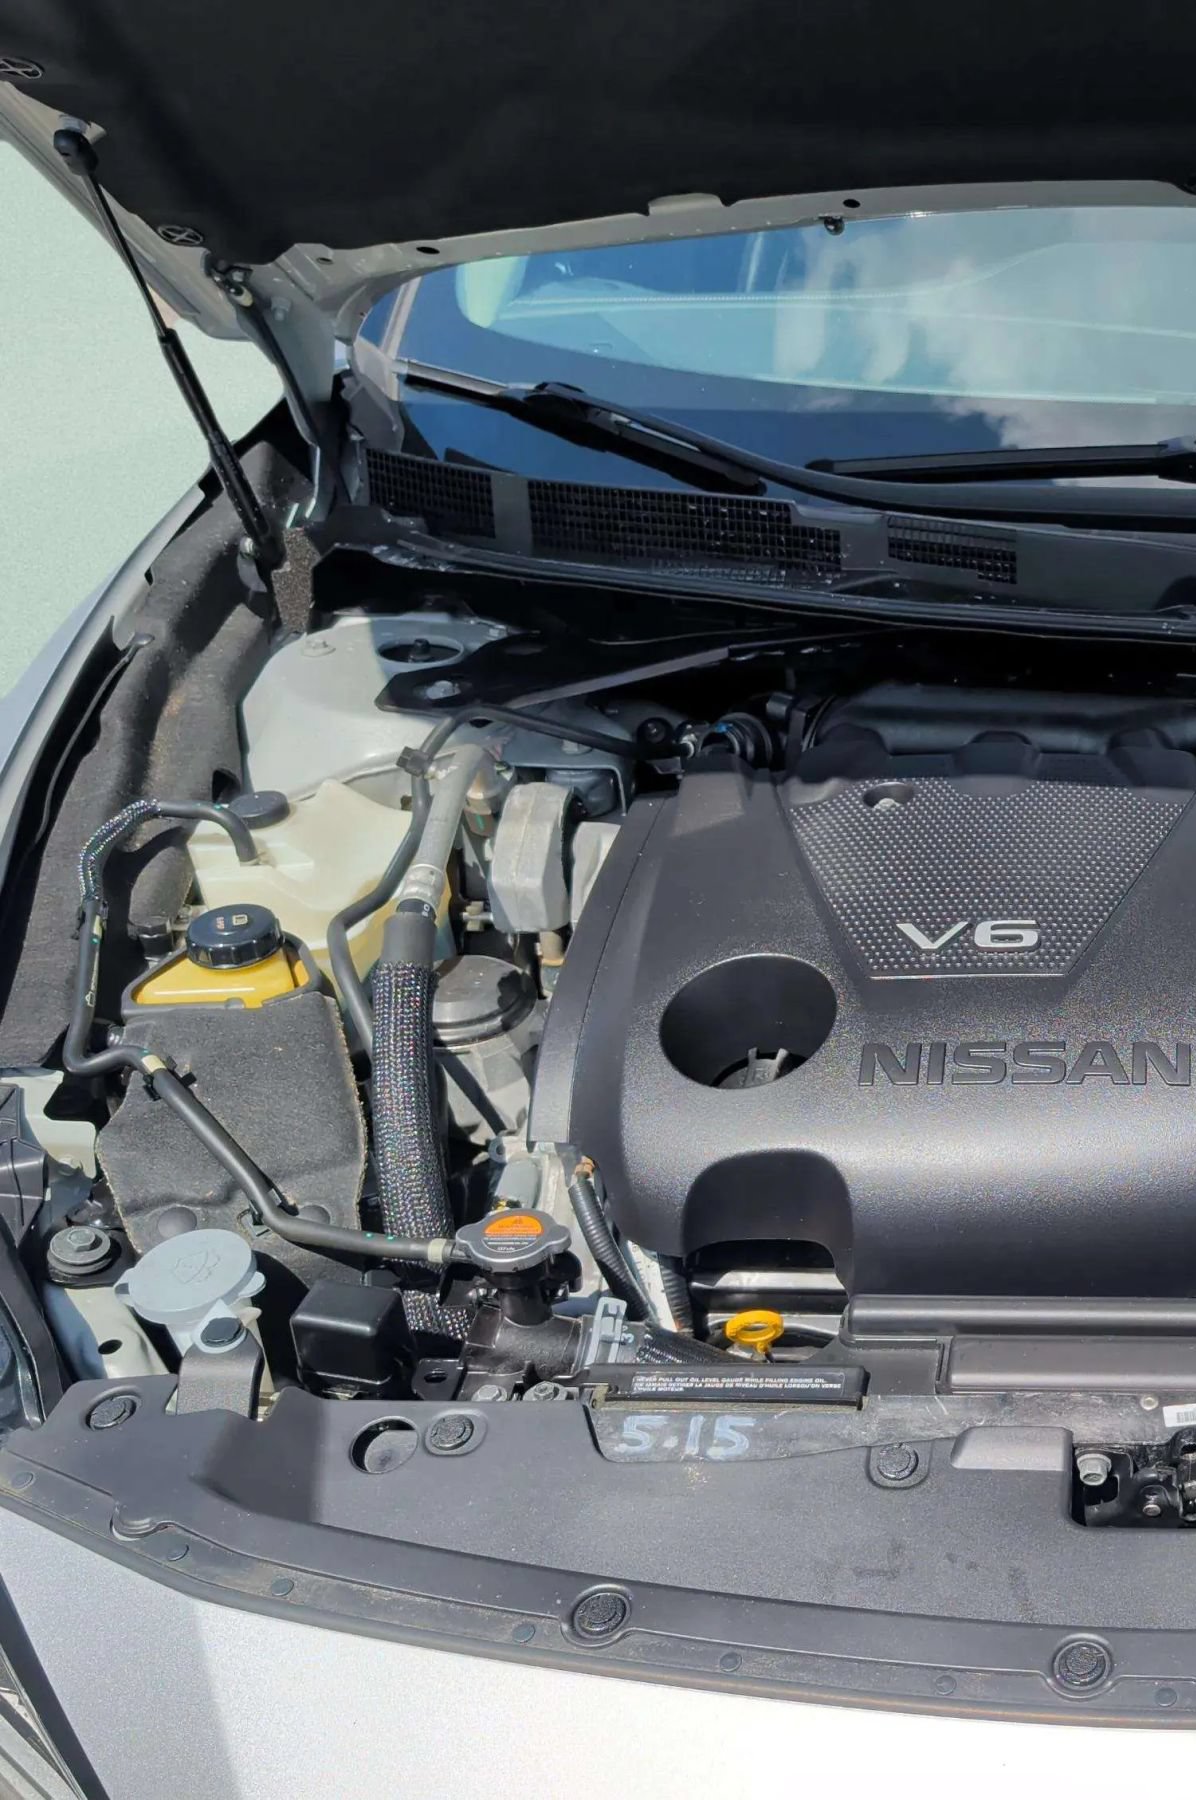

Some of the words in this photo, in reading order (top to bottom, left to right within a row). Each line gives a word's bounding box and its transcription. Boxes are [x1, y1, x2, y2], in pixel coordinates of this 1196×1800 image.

[895, 919, 1040, 950] V6
[857, 1041, 1192, 1087] NISSAN
[614, 1414, 758, 1462] 5.15
